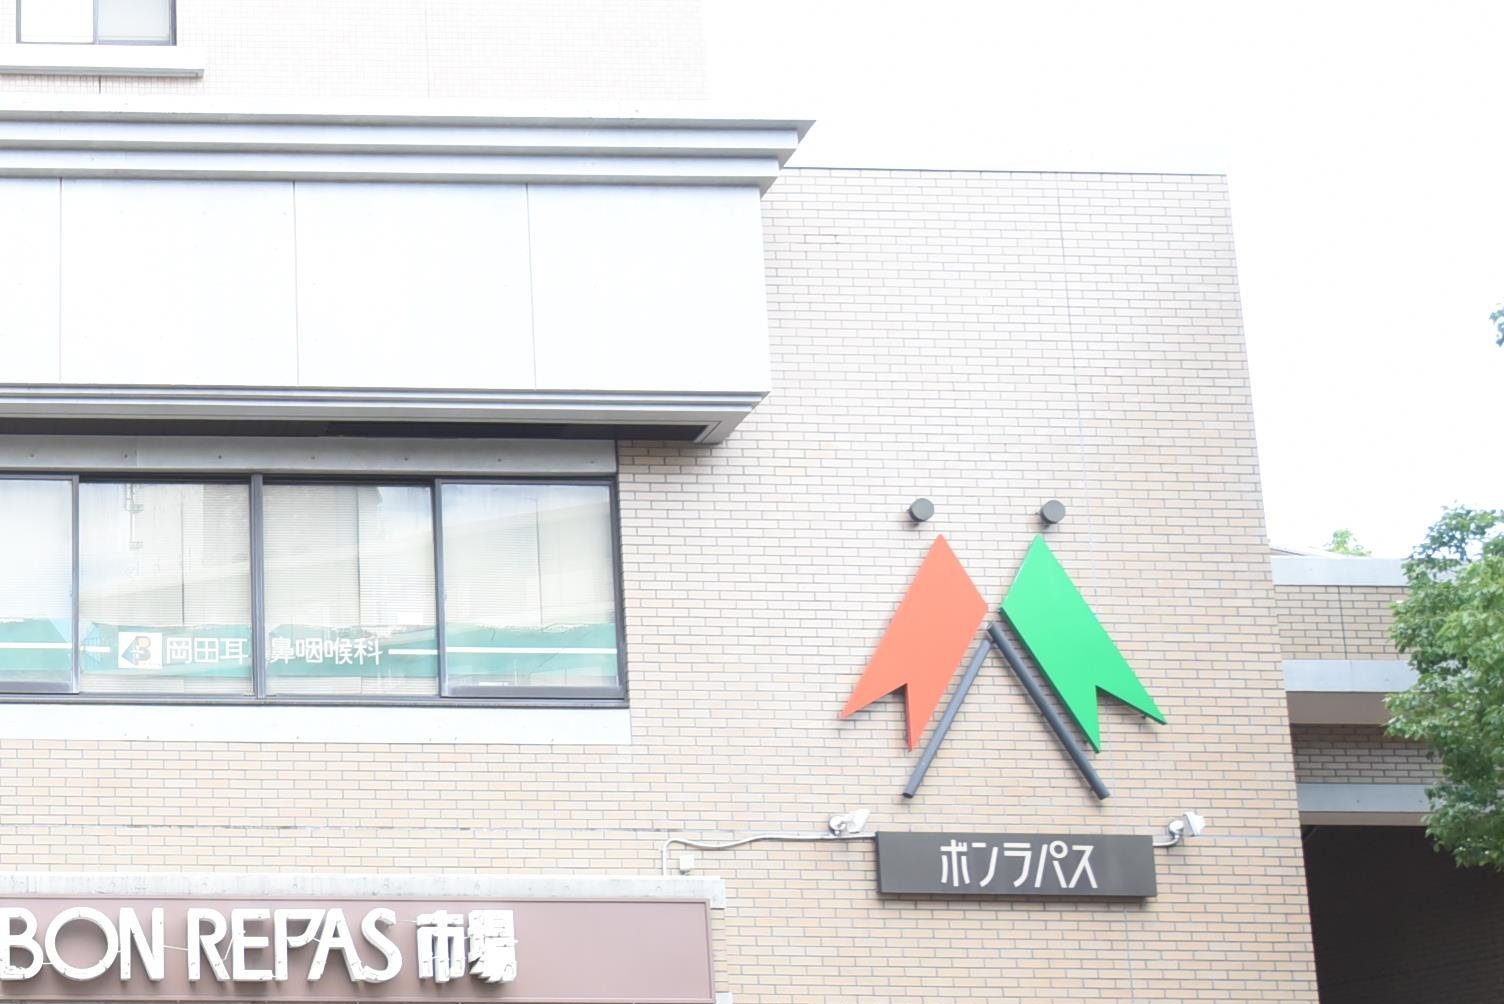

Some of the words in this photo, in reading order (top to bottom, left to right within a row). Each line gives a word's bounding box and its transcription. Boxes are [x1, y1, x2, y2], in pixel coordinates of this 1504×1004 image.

[940, 839, 1098, 889] ボンラパス
[0, 906, 165, 982] BON
[188, 906, 403, 983] REPAS
[415, 909, 518, 984] 市場
